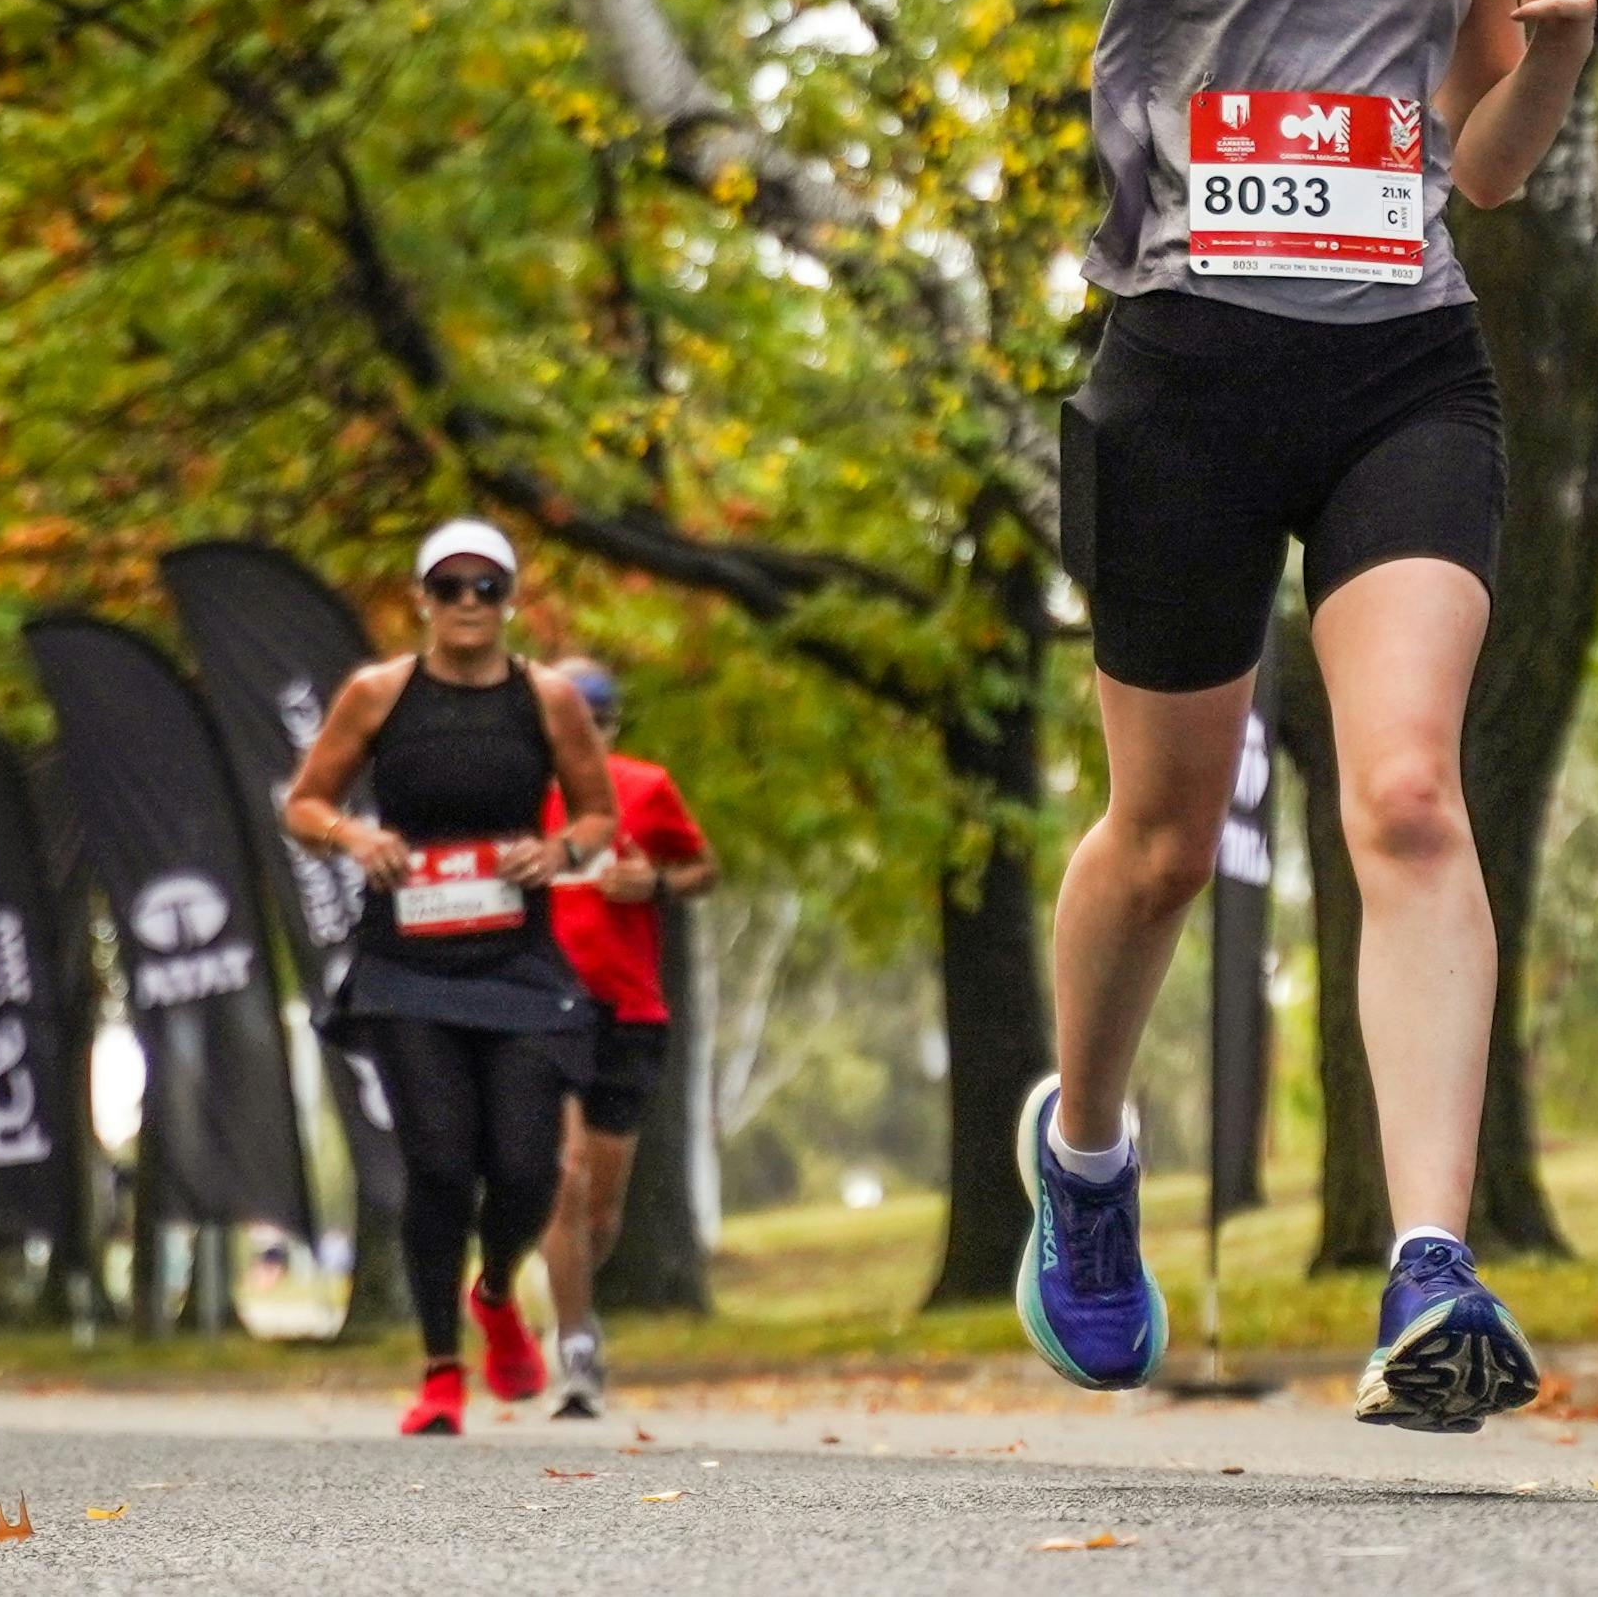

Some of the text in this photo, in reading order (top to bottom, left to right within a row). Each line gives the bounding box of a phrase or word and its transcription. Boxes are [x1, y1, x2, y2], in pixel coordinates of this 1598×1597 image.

[1334, 143, 1350, 153] 24
[1204, 175, 1331, 217] 8033
[1382, 186, 1411, 200] 21.1K
[1387, 209, 1398, 225] C
[1232, 260, 1259, 270] 8033
[1391, 268, 1414, 279] 8033
